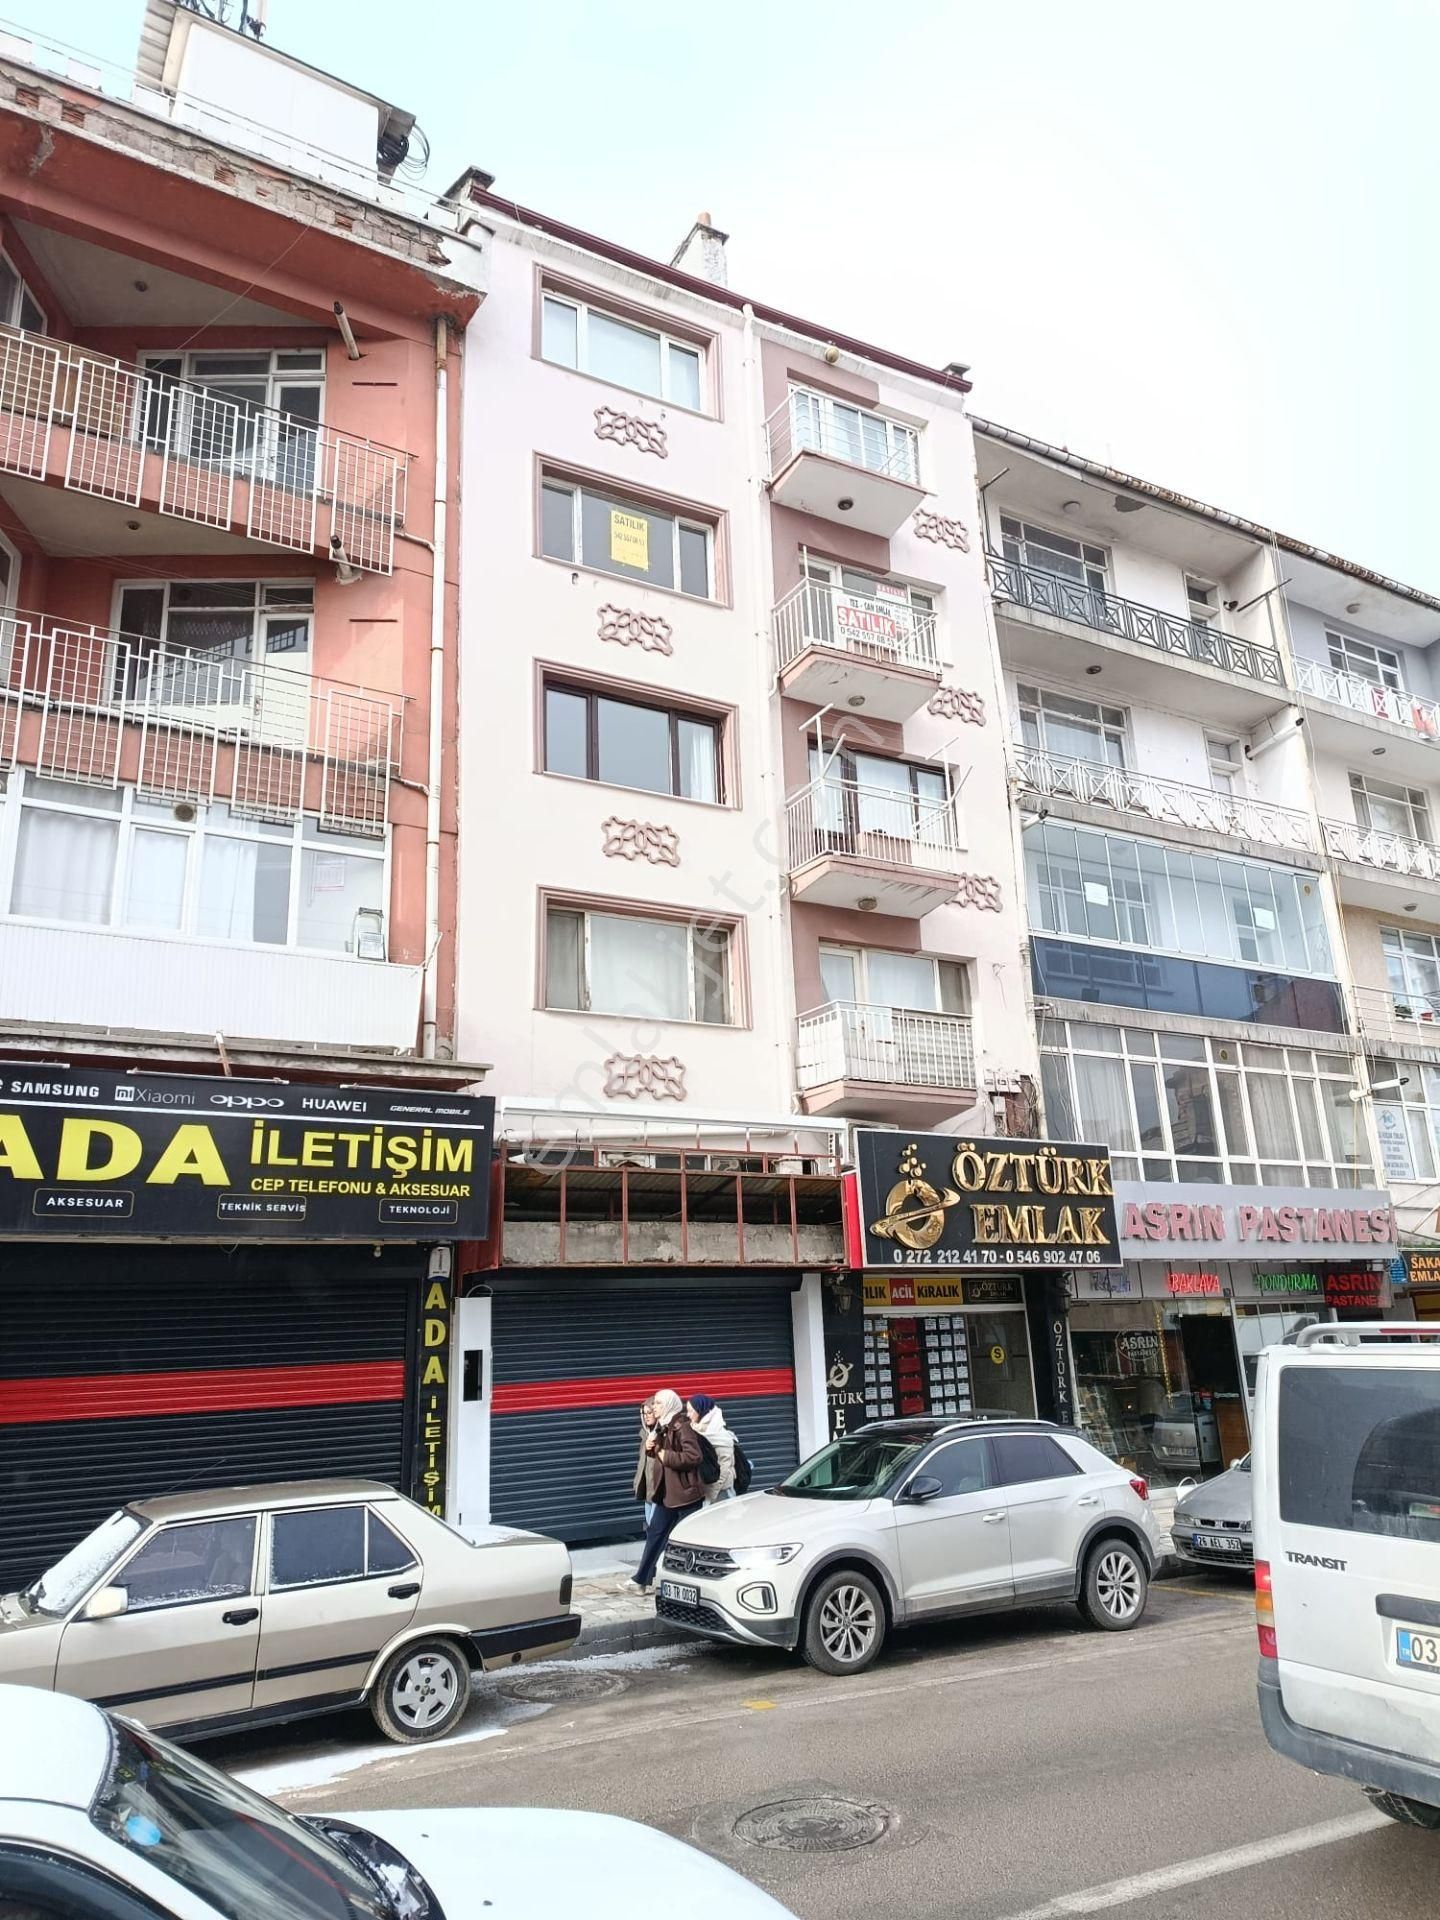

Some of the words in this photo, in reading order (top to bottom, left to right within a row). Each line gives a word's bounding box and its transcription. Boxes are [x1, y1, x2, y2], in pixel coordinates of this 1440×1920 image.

[614, 514, 645, 532] SATILIK
[838, 606, 896, 639] SATILIK
[11, 1080, 100, 1098] SAMSUNG
[136, 1088, 196, 1105] Xiaomi
[210, 1094, 285, 1108] oppo
[302, 1098, 367, 1113] HUAWEI
[389, 1105, 434, 1115] GENERAL
[250, 1120, 474, 1179] İLETİŞİM
[952, 1142, 1115, 1196] ÖZTÜRK
[251, 1178, 284, 1192] CEP
[288, 1179, 372, 1195] TELEFONU
[375, 1182, 386, 1195] &
[389, 1183, 471, 1197] AKSESUAR
[46, 1197, 124, 1208] AKSESUAR
[220, 1202, 262, 1211] TEKNİK
[266, 1203, 306, 1212] SERVİS
[389, 1205, 450, 1214] TEKNOLOJİ
[970, 1204, 1110, 1245] EMLAK
[893, 1249, 902, 1263] 0
[907, 1249, 931, 1263] 272
[937, 1249, 960, 1263] 212
[963, 1249, 978, 1263] 41
[981, 1249, 997, 1263] 70
[1006, 1249, 1014, 1263] 0
[1017, 1249, 1040, 1263] 546
[1043, 1249, 1066, 1263] 902
[1069, 1249, 1083, 1263] 47
[1086, 1249, 1100, 1263] 06
[1171, 1273, 1221, 1294] BAKLAVA
[1258, 1273, 1318, 1292] DONDURMA
[892, 1285, 914, 1299] ACİL
[423, 1283, 447, 1385] ADA
[1120, 1336, 1158, 1350] ASRIN
[1286, 1551, 1347, 1571] TRANSIT
[1411, 1636, 1438, 1664] 03
